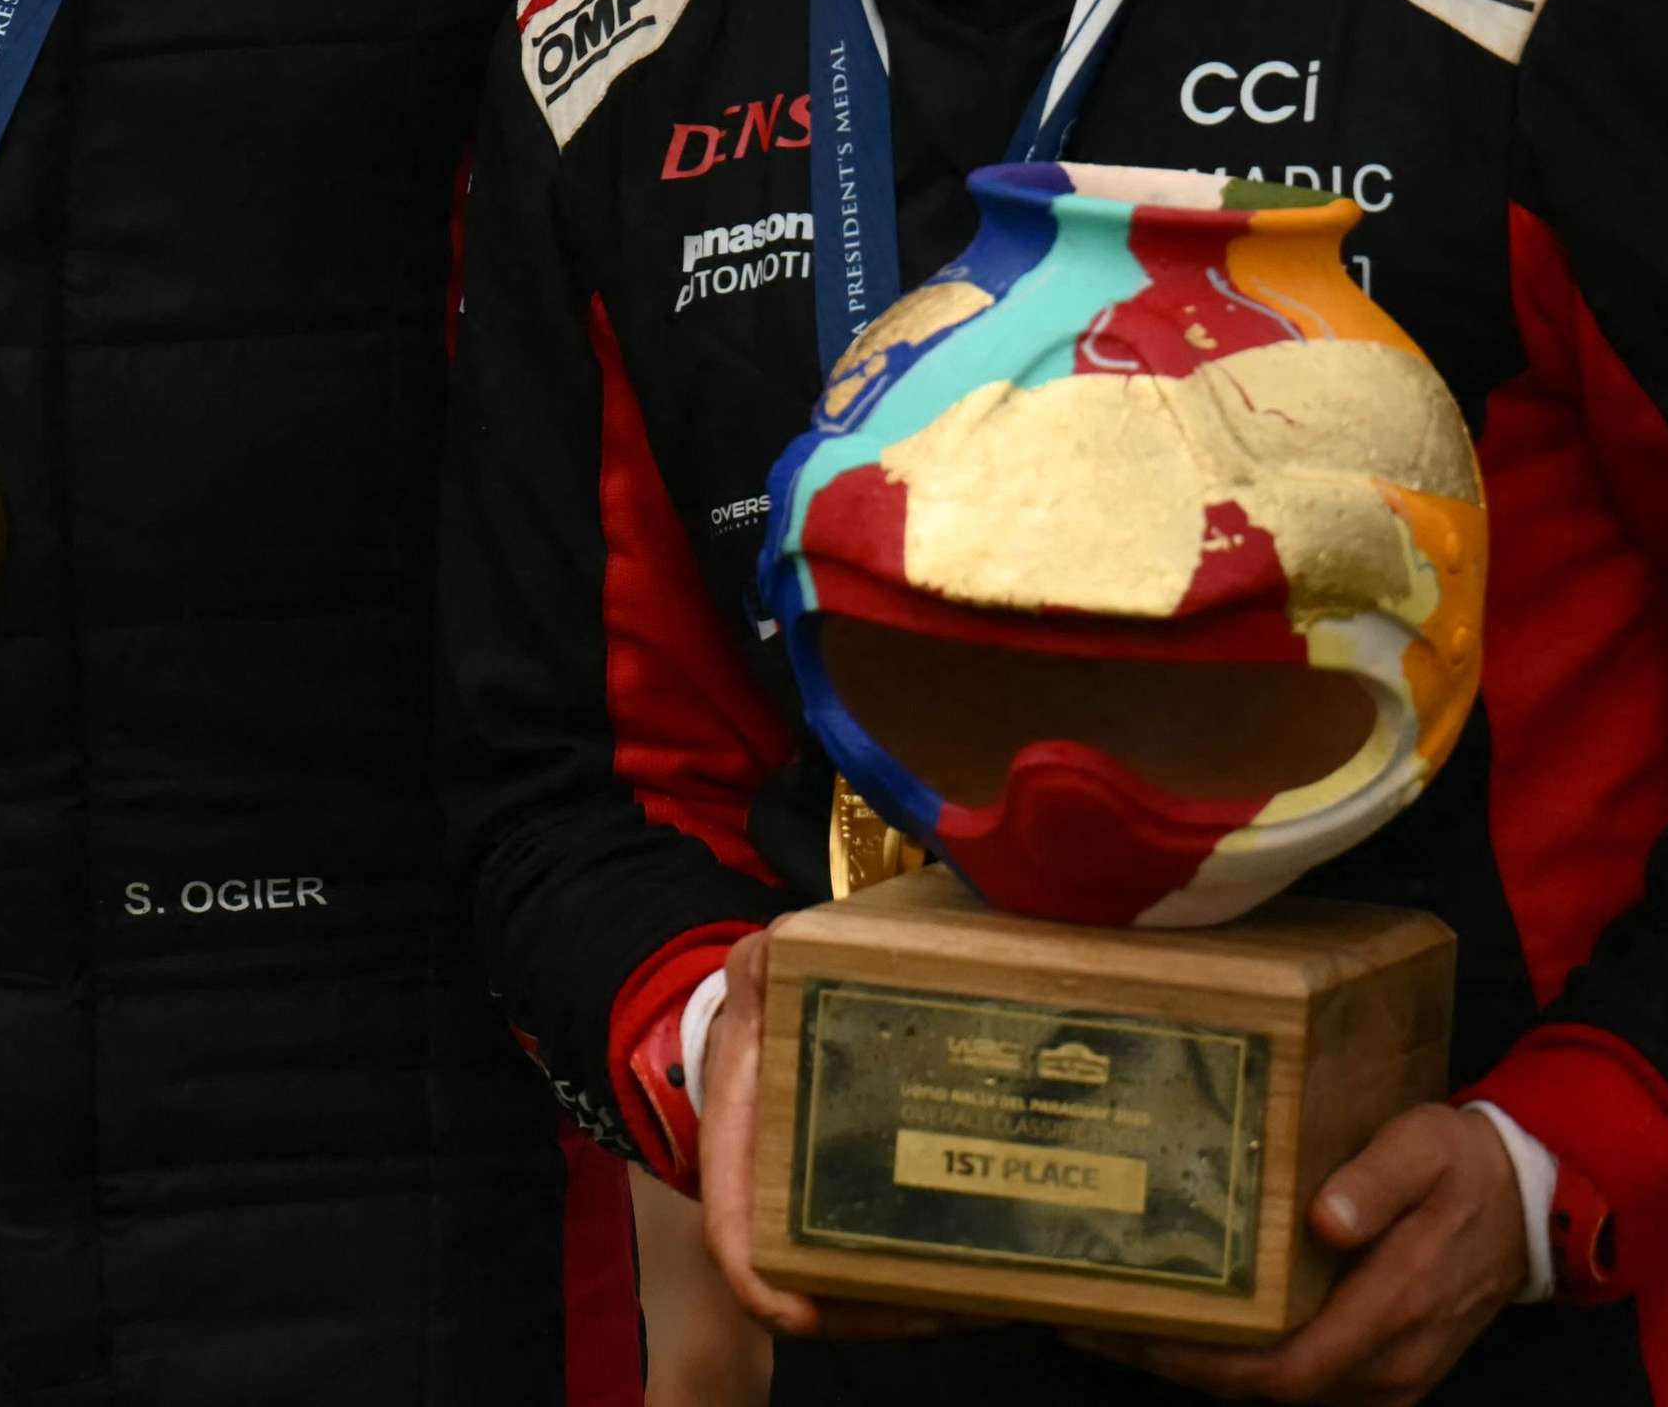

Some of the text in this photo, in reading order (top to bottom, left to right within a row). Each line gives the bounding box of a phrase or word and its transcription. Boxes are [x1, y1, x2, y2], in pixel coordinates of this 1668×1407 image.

[831, 40, 853, 137] MEDAL
[711, 494, 772, 524] OVERS
[124, 876, 328, 916] S. OGIER
[943, 1149, 1101, 1191] 1ST PLACE
